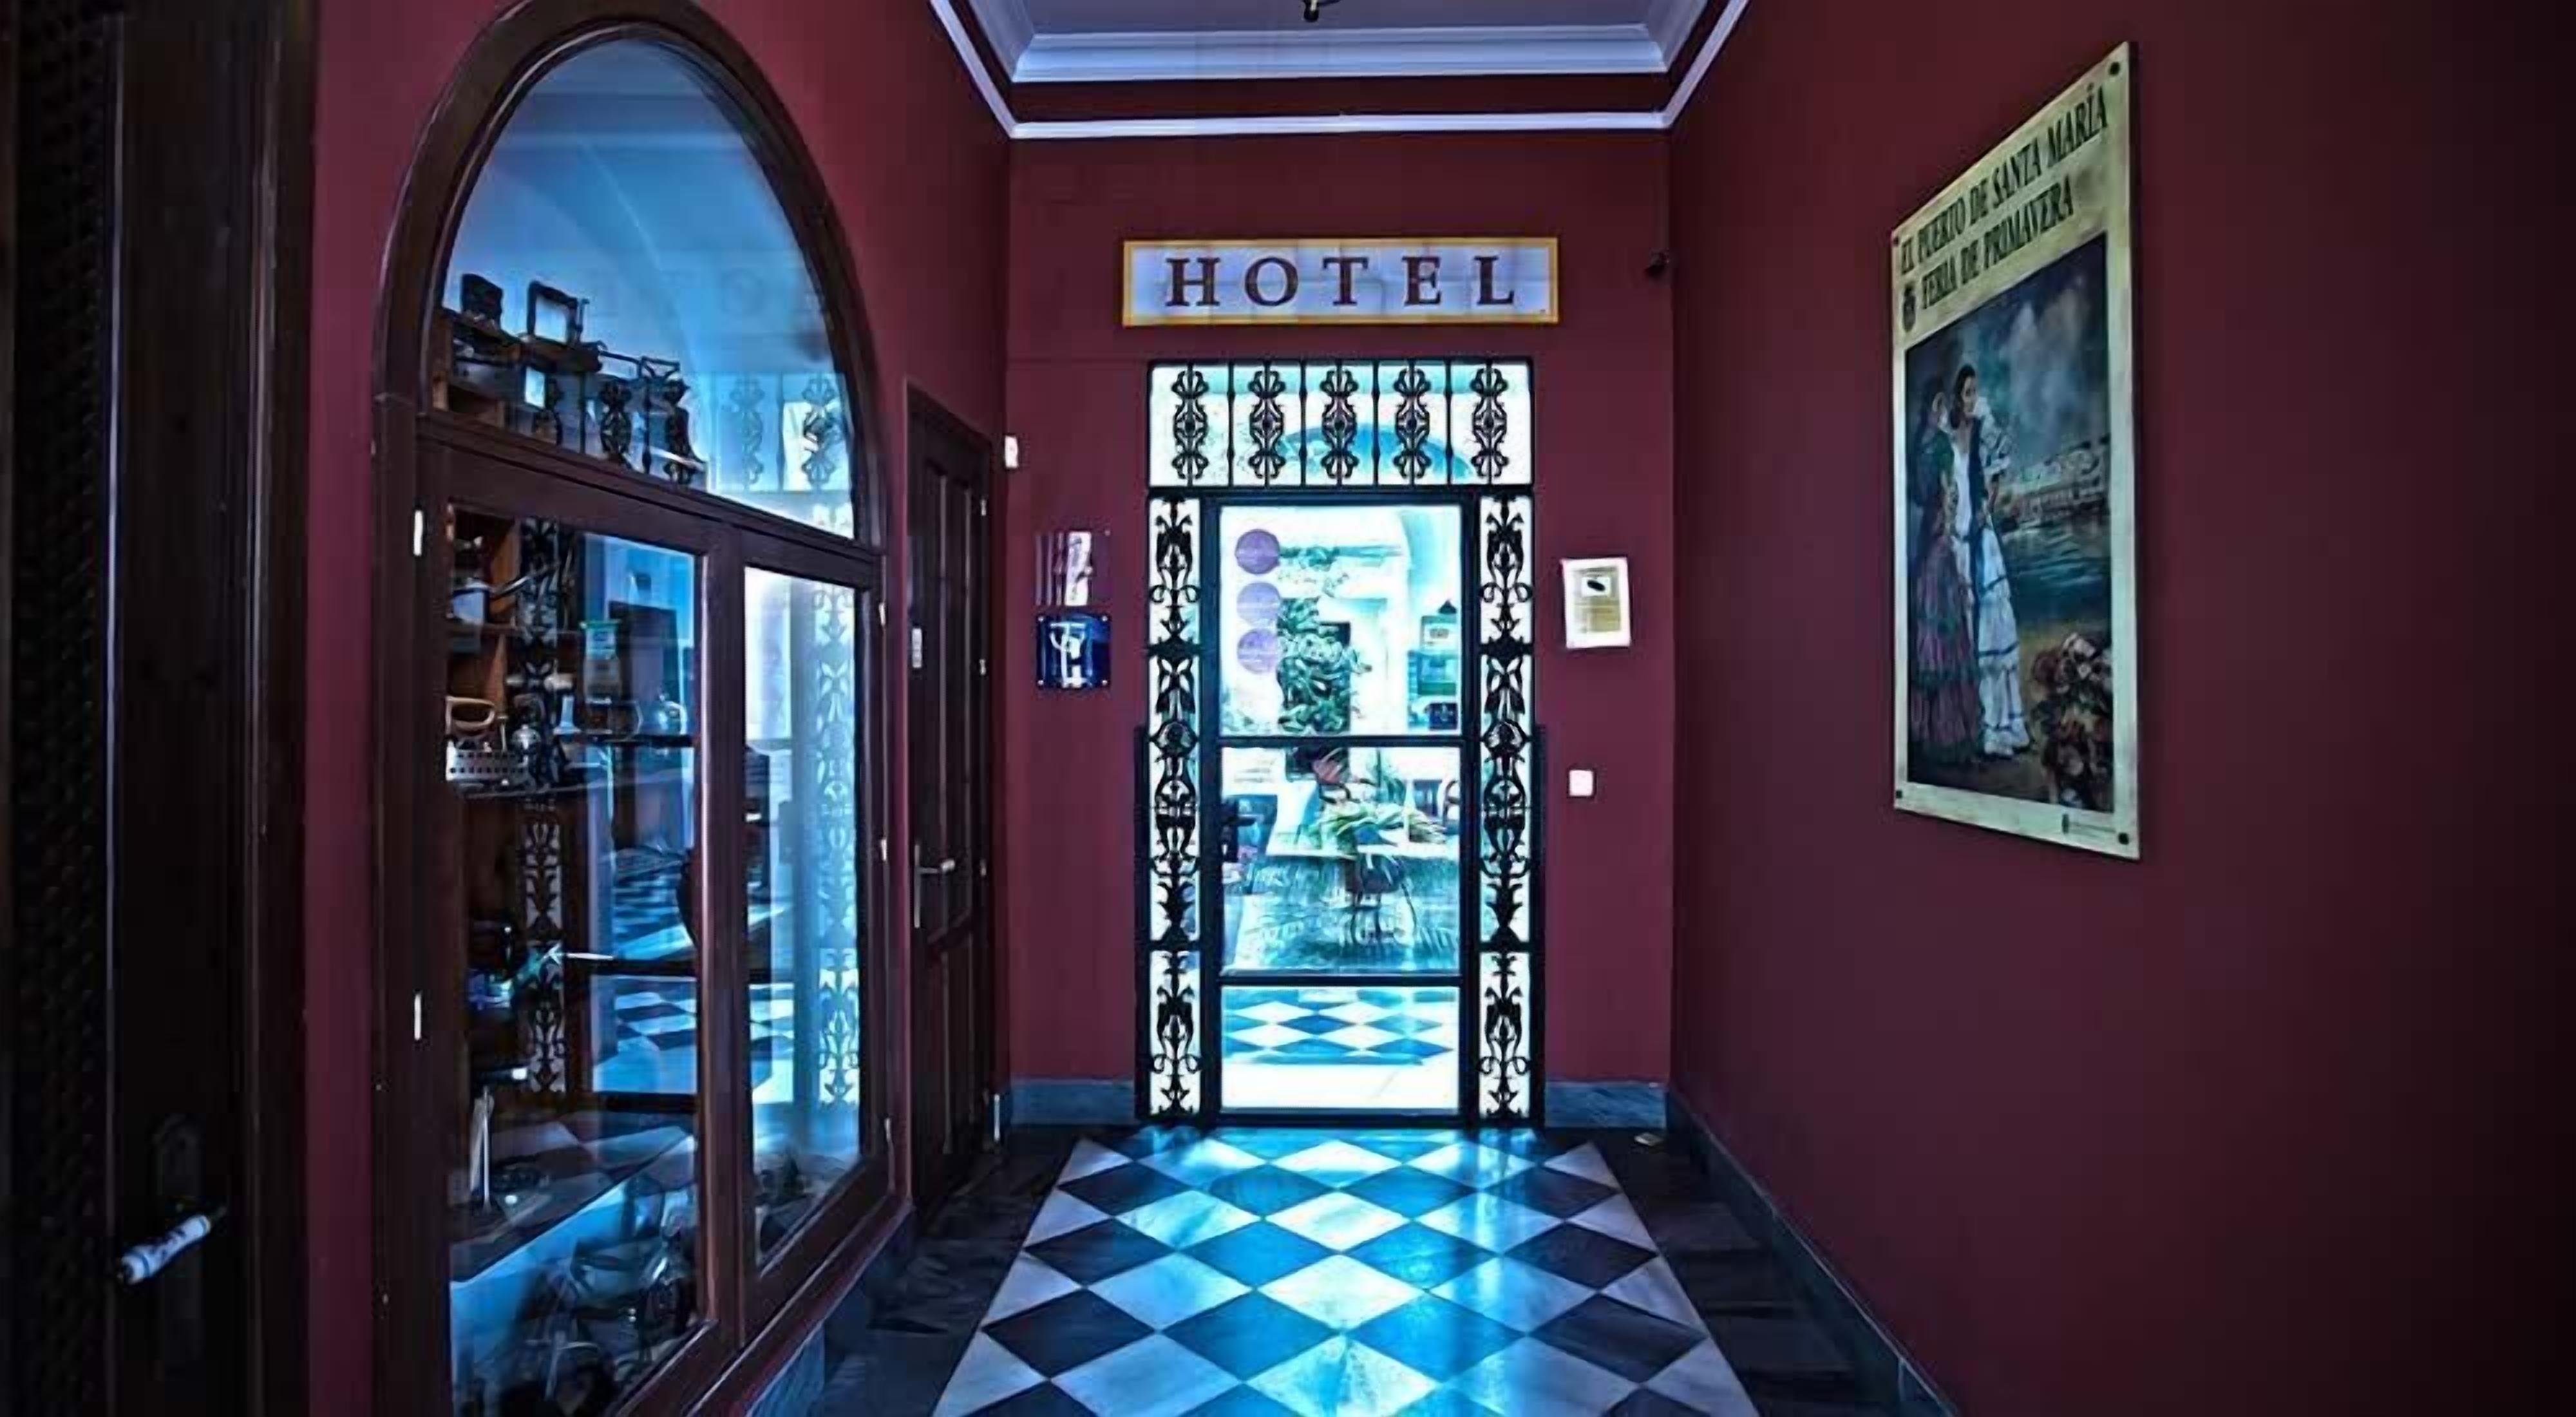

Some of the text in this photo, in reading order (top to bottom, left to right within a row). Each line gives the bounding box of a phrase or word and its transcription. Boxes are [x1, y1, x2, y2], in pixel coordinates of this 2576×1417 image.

[1918, 196, 1966, 263] PUERTO
[1969, 178, 1989, 225] DE
[1992, 136, 2041, 209] SANTA
[2047, 82, 2107, 168] MARÍA
[1166, 256, 1515, 307] HOTEL
[1922, 173, 2074, 309] FERIA DE PRIMAVERA
